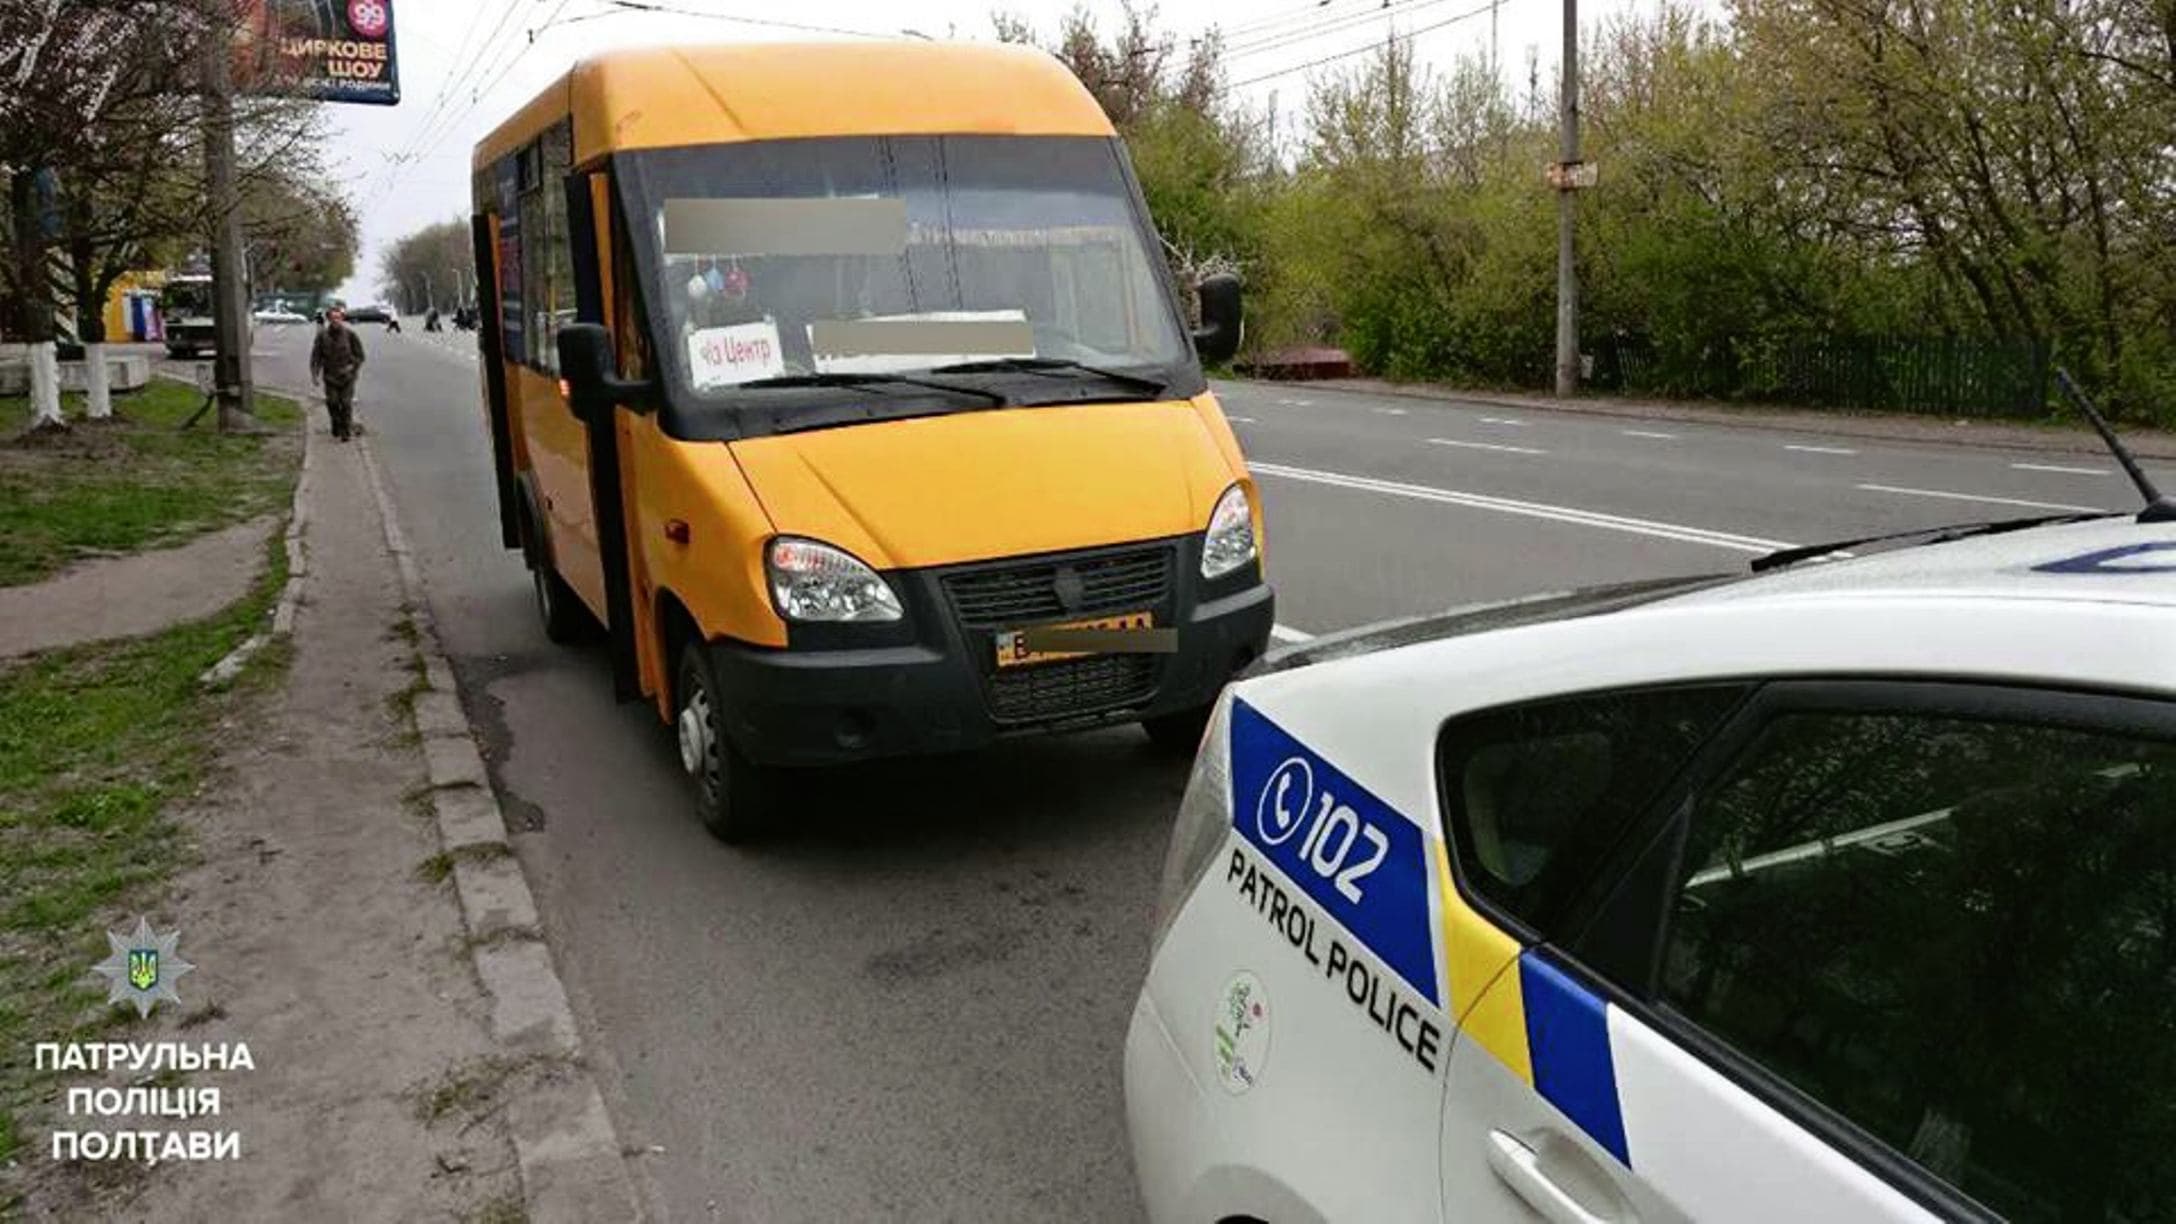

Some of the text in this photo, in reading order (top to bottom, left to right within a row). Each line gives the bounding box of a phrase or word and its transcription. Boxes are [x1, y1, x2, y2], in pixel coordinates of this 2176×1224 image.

[281, 38, 388, 60] ЦИРКОВЕ
[327, 60, 383, 78] ШОУ
[723, 337, 771, 369] Центр
[1298, 791, 1389, 904] 102
[1227, 848, 1320, 966] PATROL
[1326, 941, 1441, 1074] POLICE
